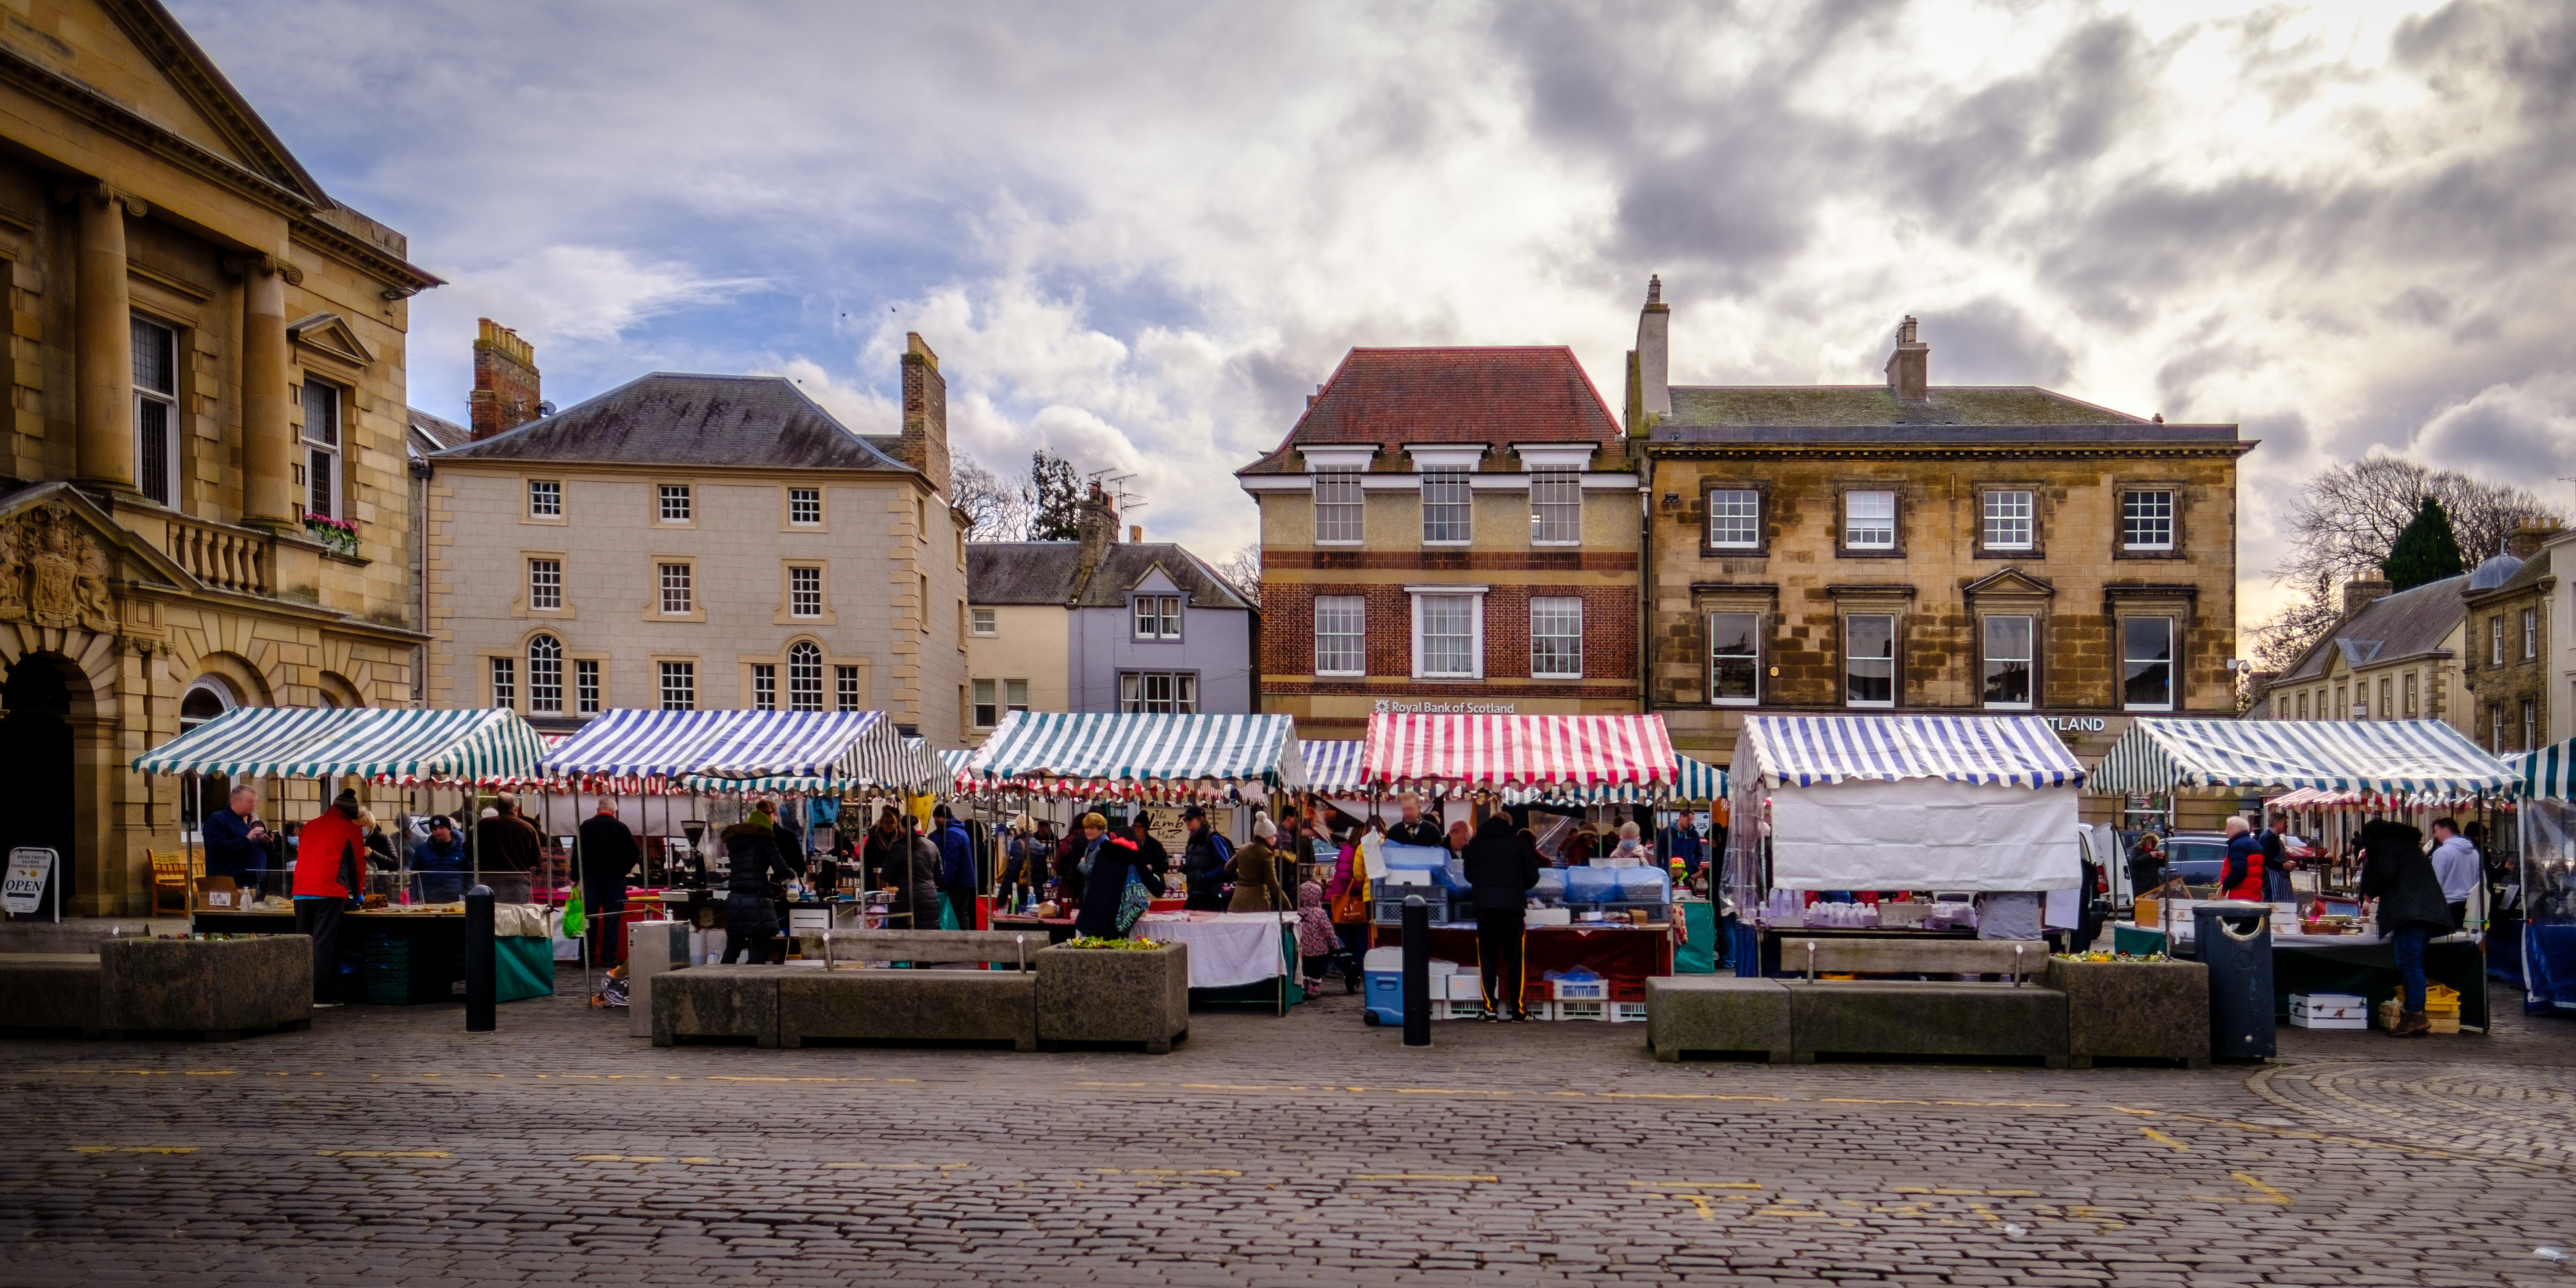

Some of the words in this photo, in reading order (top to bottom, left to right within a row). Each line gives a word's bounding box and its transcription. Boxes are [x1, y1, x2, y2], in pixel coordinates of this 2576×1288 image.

[1392, 702, 1422, 715] Royal
[1424, 702, 1451, 713] Bank
[1452, 702, 1465, 713] of
[1467, 703, 1514, 714] Scotland
[2047, 717, 2105, 731] TLAND
[1155, 810, 1167, 819] The
[1148, 813, 1185, 831] Lamb
[1157, 830, 1176, 839] Man
[5, 880, 43, 892] OPEN
